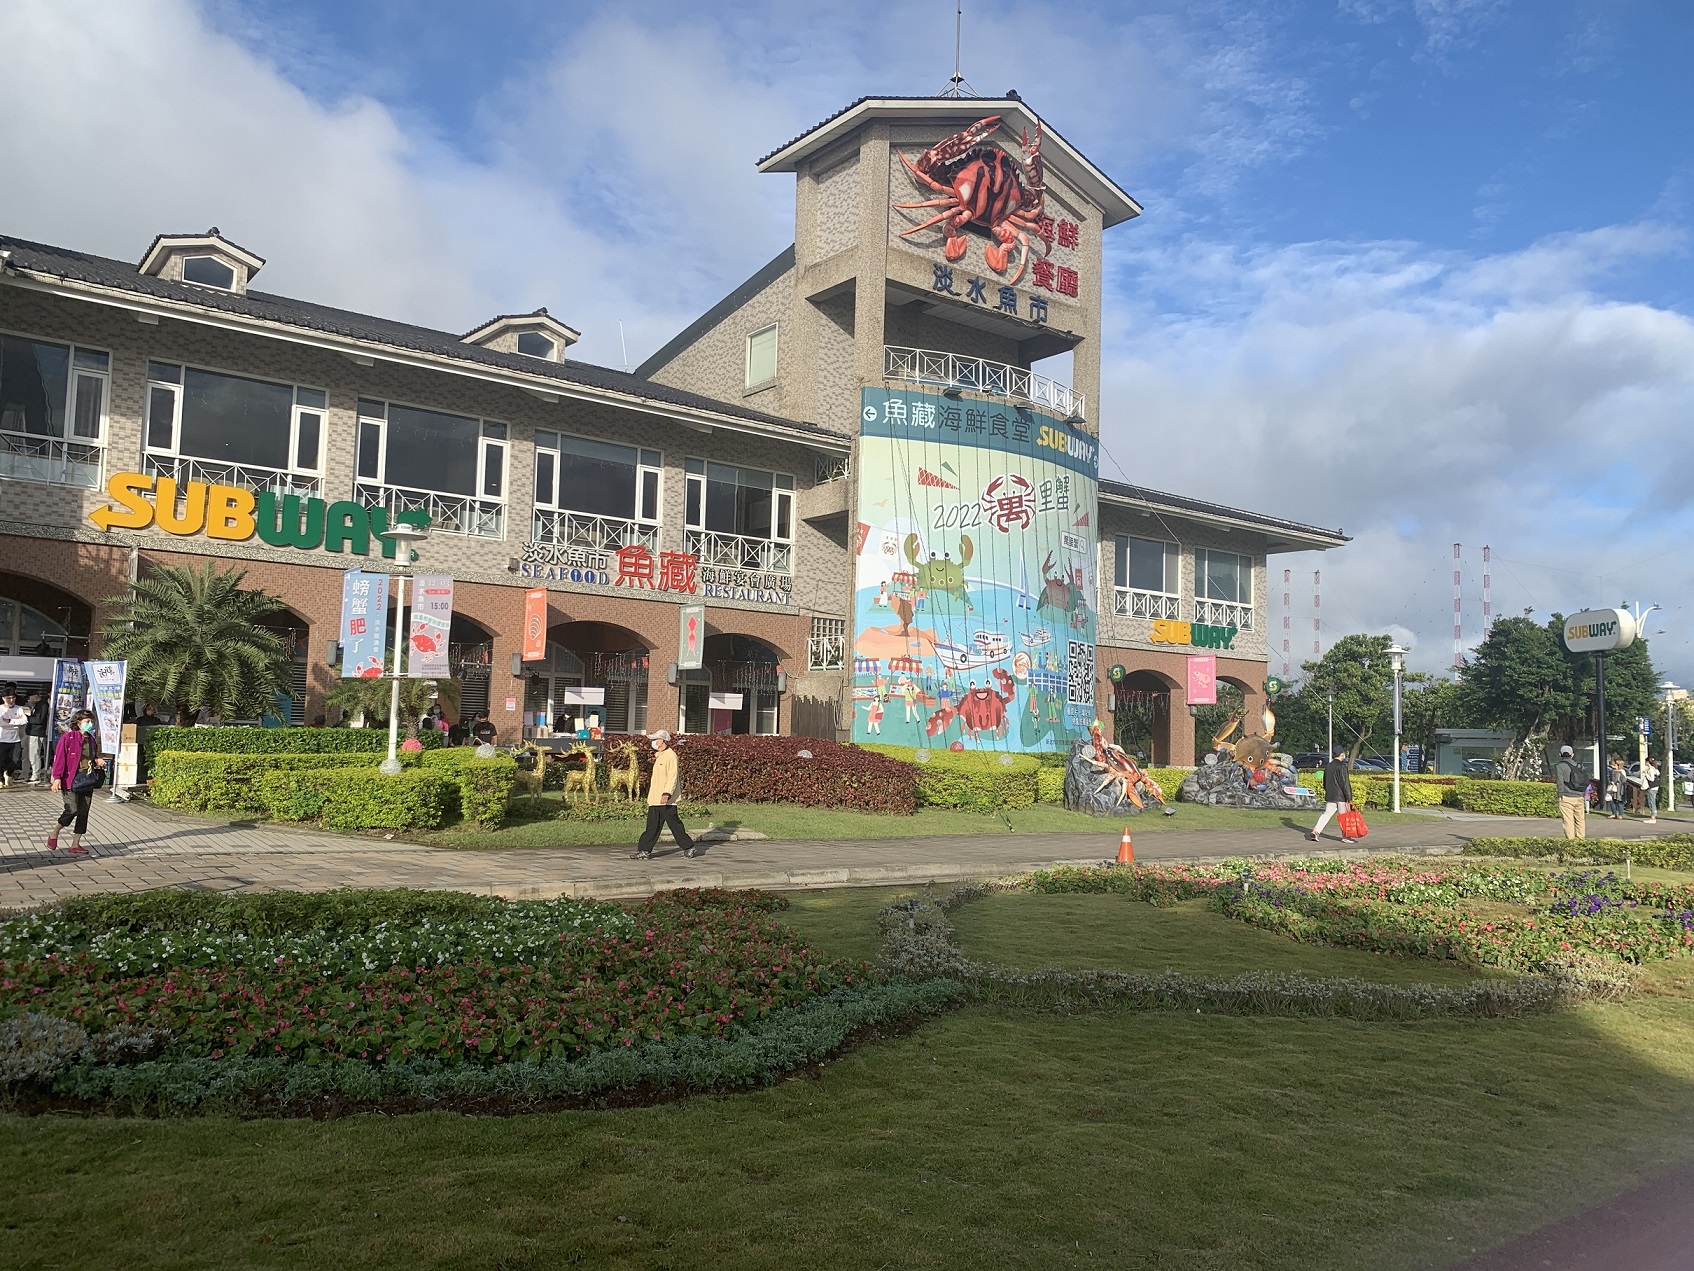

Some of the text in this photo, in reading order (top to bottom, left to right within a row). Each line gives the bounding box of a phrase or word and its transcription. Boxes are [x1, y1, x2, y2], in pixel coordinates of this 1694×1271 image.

[933, 263, 1049, 323] 淡水魚市
[1032, 257, 1079, 298] 餐廳
[1037, 426, 1094, 463] SUBWAY
[88, 472, 432, 558] SUBWAY
[521, 541, 609, 571] 淡水魚市
[614, 545, 698, 594] 魚藏
[521, 563, 610, 586] SEAFOOD
[702, 566, 793, 593] 海鮮宴會廣場
[418, 579, 426, 610] 淡水魚市
[430, 602, 449, 610] 15:00
[704, 583, 792, 605] RESTAURANT
[349, 579, 371, 654] 螃蟹肥了
[1567, 620, 1618, 641] SUBWAY
[1150, 619, 1238, 650] SUBWAY
